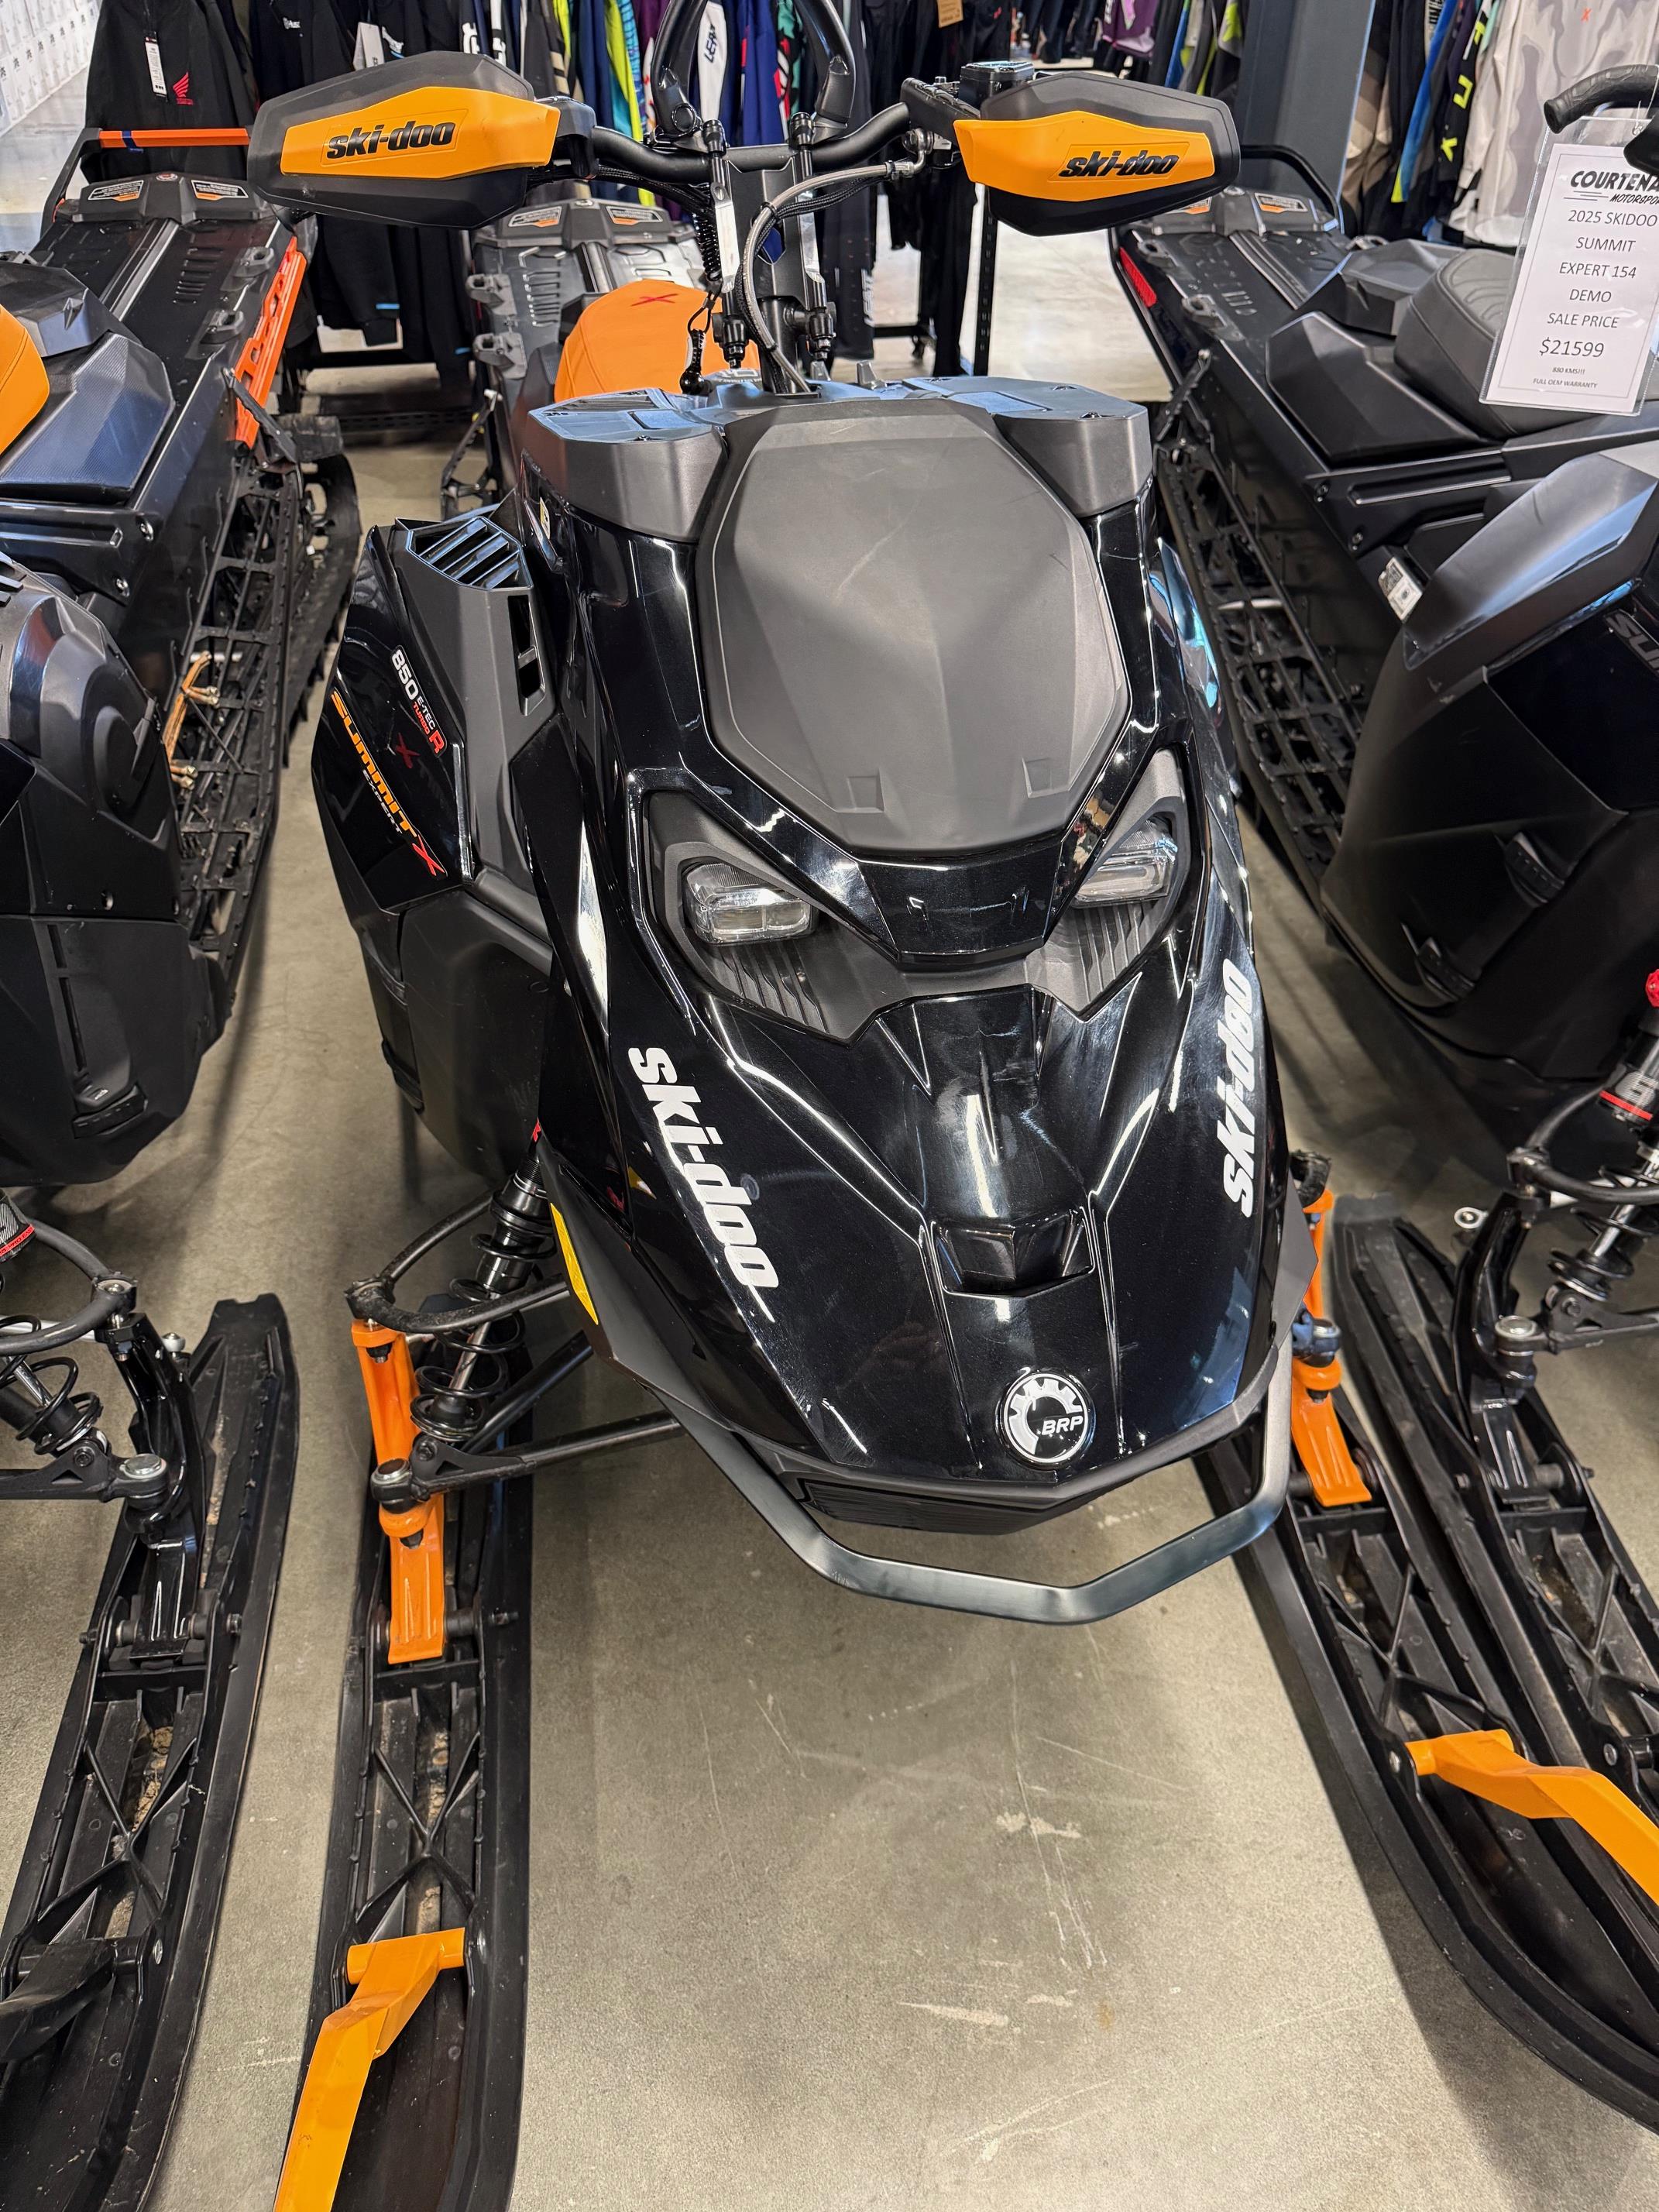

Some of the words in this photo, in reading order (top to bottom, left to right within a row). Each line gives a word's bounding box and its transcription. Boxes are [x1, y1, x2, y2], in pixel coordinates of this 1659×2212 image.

[327, 120, 455, 159] ski-doo
[1058, 149, 1180, 177] ski-doo
[1568, 210, 1602, 223] 2025
[1604, 212, 1658, 227] SKIDOO
[1575, 237, 1637, 252] SUMMIT
[1559, 262, 1610, 276] EXPERT
[1612, 266, 1637, 279] 154
[1569, 289, 1612, 303] DEMO
[1547, 312, 1579, 325] SALE
[1582, 315, 1620, 328] PRICE
[1539, 337, 1605, 358] $21599
[1564, 380, 1598, 389] WARRANTY
[392, 649, 419, 700] 850
[417, 696, 436, 730] E-TEC
[412, 701, 431, 735] TURBO
[428, 730, 445, 754] R
[331, 690, 417, 837] SUMMIT
[362, 769, 403, 834] EXPERT
[1217, 958, 1255, 1218] ski-doo
[628, 1047, 779, 1288] ski-doo
[1042, 1415, 1084, 1436] BRP
